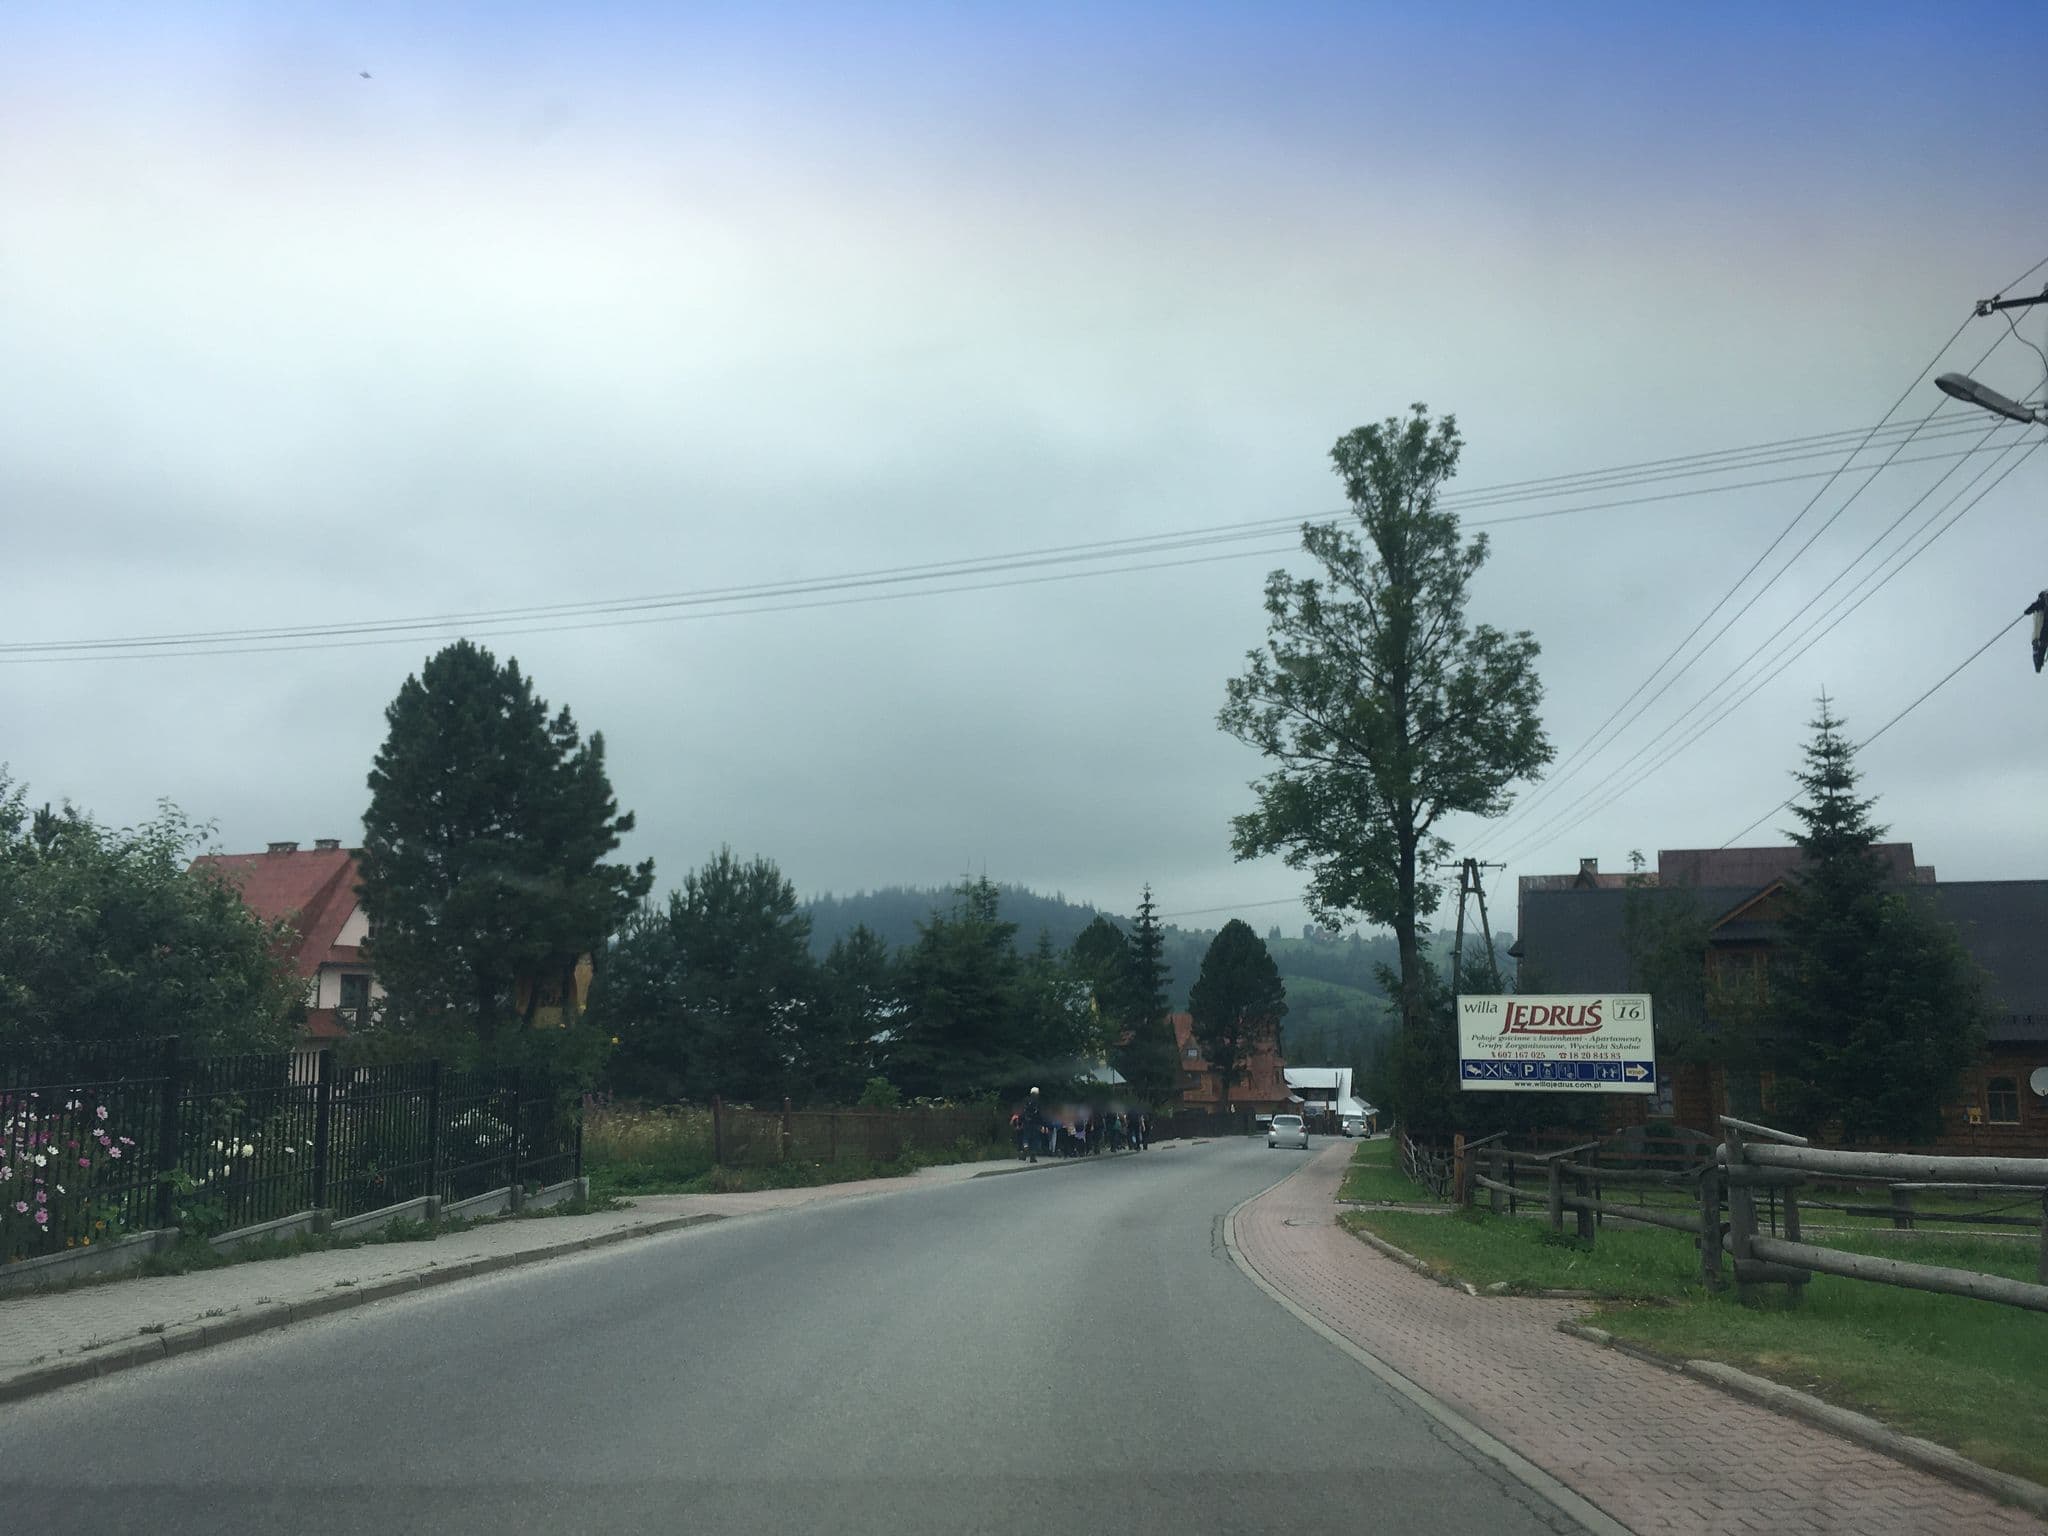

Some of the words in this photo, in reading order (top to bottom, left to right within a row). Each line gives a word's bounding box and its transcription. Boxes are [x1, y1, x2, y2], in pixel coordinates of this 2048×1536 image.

[1464, 1001, 1498, 1014] willa
[1617, 1006, 1640, 1019] 16
[1499, 1000, 1603, 1035] JĘDRUŚ
[1471, 1034, 1496, 1043] Pokoje
[1590, 1035, 1642, 1043] Apartamenty
[1478, 1042, 1503, 1050] Grupy
[1497, 1051, 1512, 1059] 607
[1515, 1051, 1528, 1059] 167
[1530, 1051, 1546, 1059] 025
[1569, 1052, 1579, 1060] 18
[1581, 1052, 1591, 1060] 20
[1524, 1064, 1534, 1076] P
[1514, 1081, 1602, 1089] www.willajedrus.com.pl
